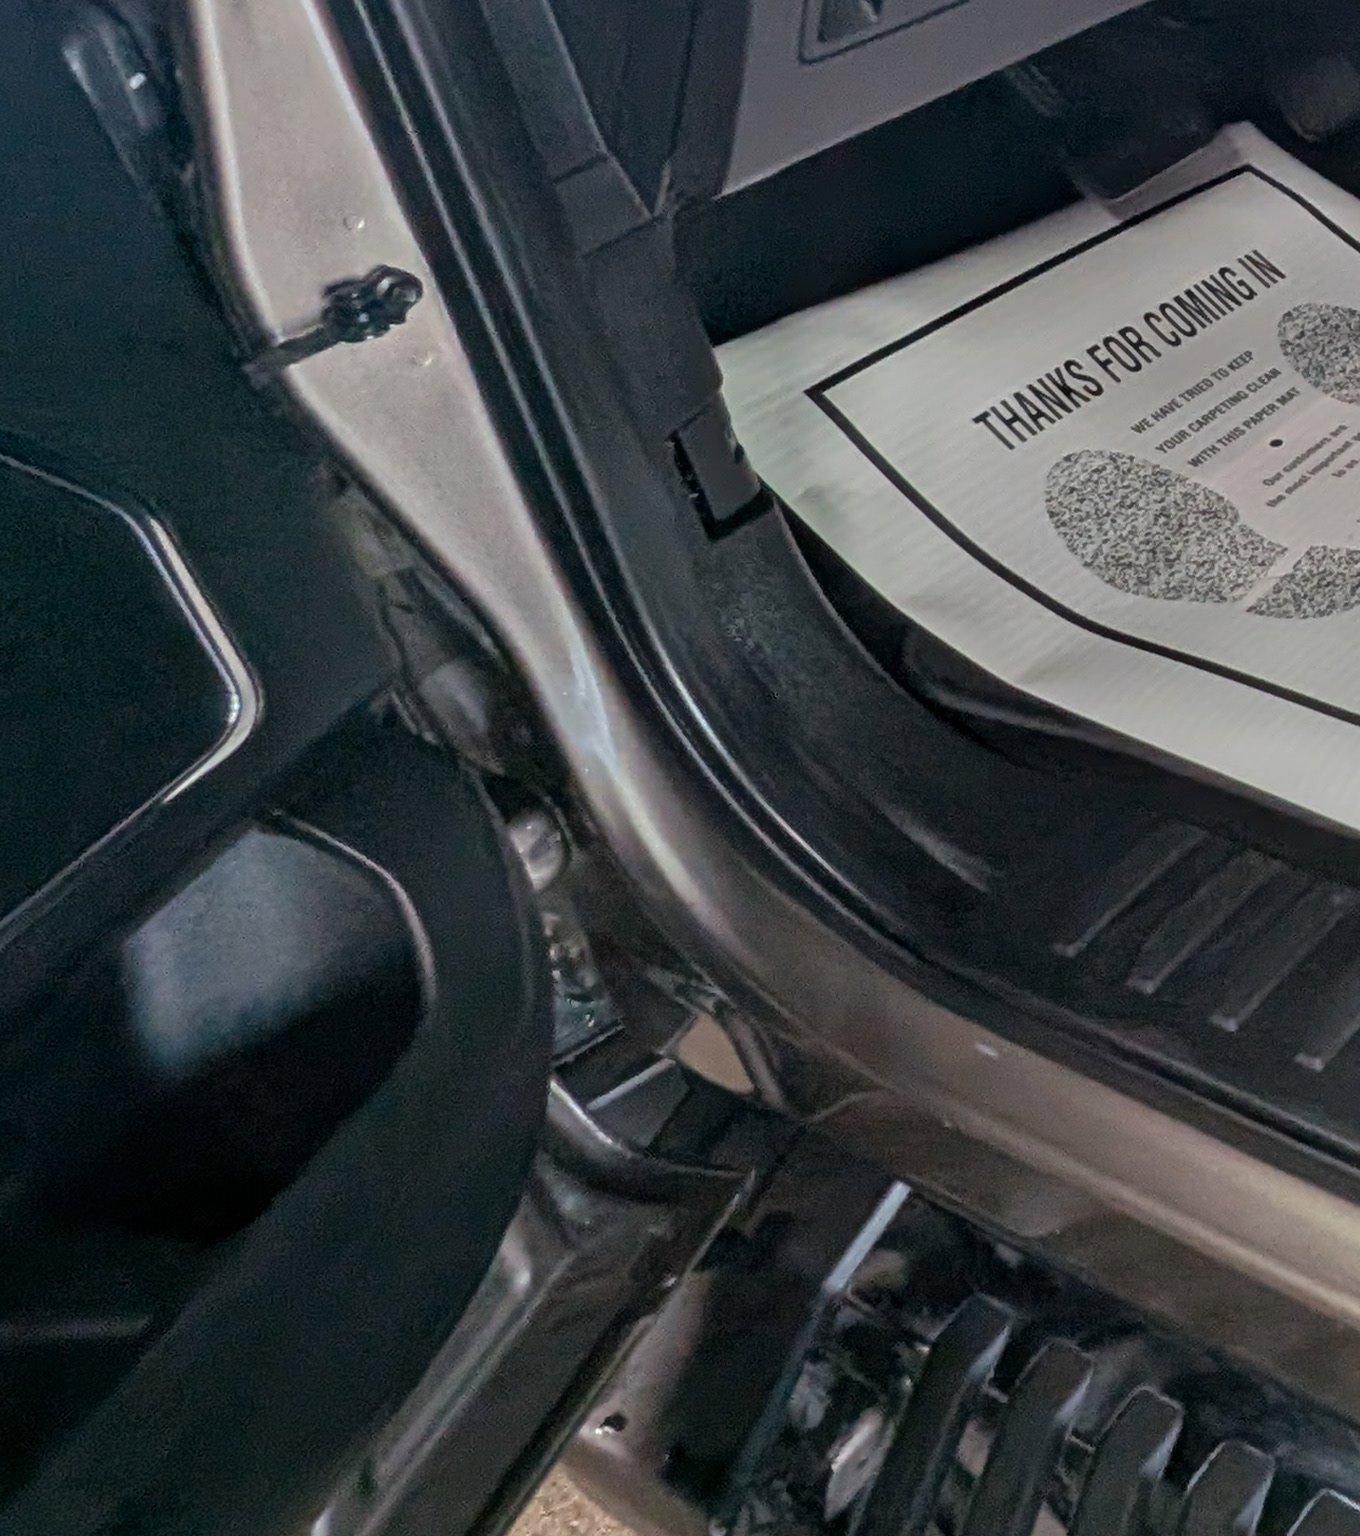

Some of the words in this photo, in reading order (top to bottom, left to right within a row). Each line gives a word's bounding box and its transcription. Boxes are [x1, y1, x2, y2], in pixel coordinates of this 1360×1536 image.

[972, 359, 1104, 451] THANKS
[1086, 326, 1162, 384] FOR
[1143, 266, 1258, 347] COMING
[1237, 249, 1287, 288] IN
[1130, 418, 1155, 434] WE
[1151, 398, 1184, 422] HAVE
[1178, 377, 1215, 403] TRIED
[1210, 367, 1230, 381] TO
[1227, 350, 1254, 372] KEEP
[1155, 429, 1192, 454] YOUR
[1187, 390, 1249, 433] CARPETING
[1245, 367, 1282, 394] CLEAN
[1187, 444, 1221, 468] WITH
[1216, 426, 1246, 447] THIS
[1242, 402, 1280, 430] PAPER
[1275, 386, 1301, 406] MAT
